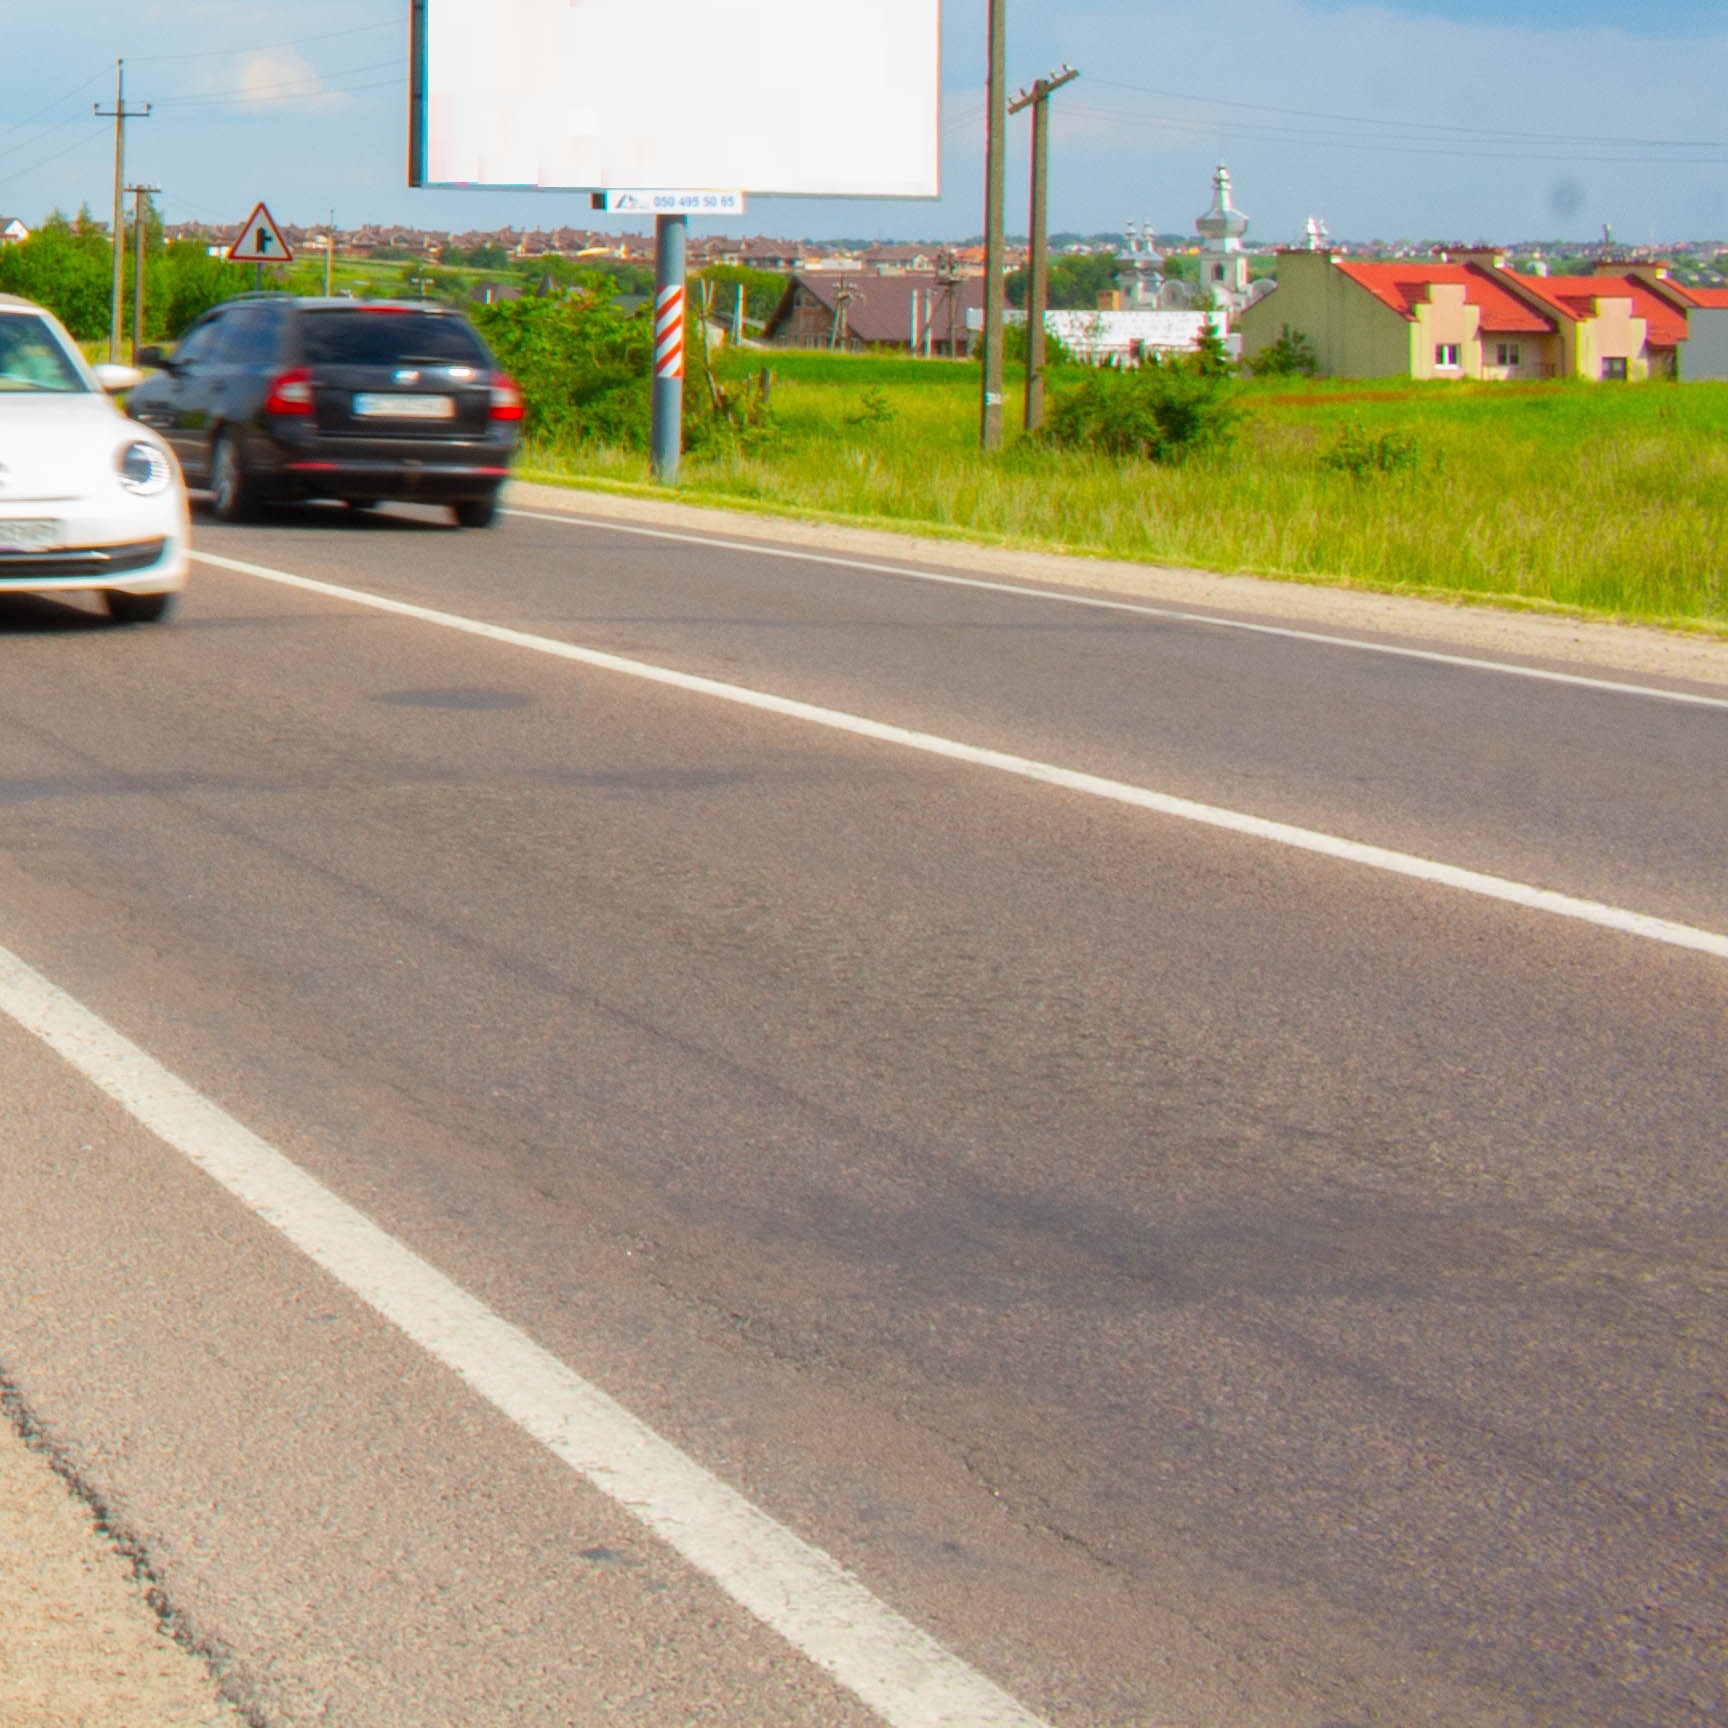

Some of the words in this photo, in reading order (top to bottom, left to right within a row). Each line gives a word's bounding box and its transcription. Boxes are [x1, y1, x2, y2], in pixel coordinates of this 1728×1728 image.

[654, 195, 675, 207] 050
[679, 195, 700, 207] 495
[703, 195, 717, 207] 50
[721, 195, 735, 207] 65
